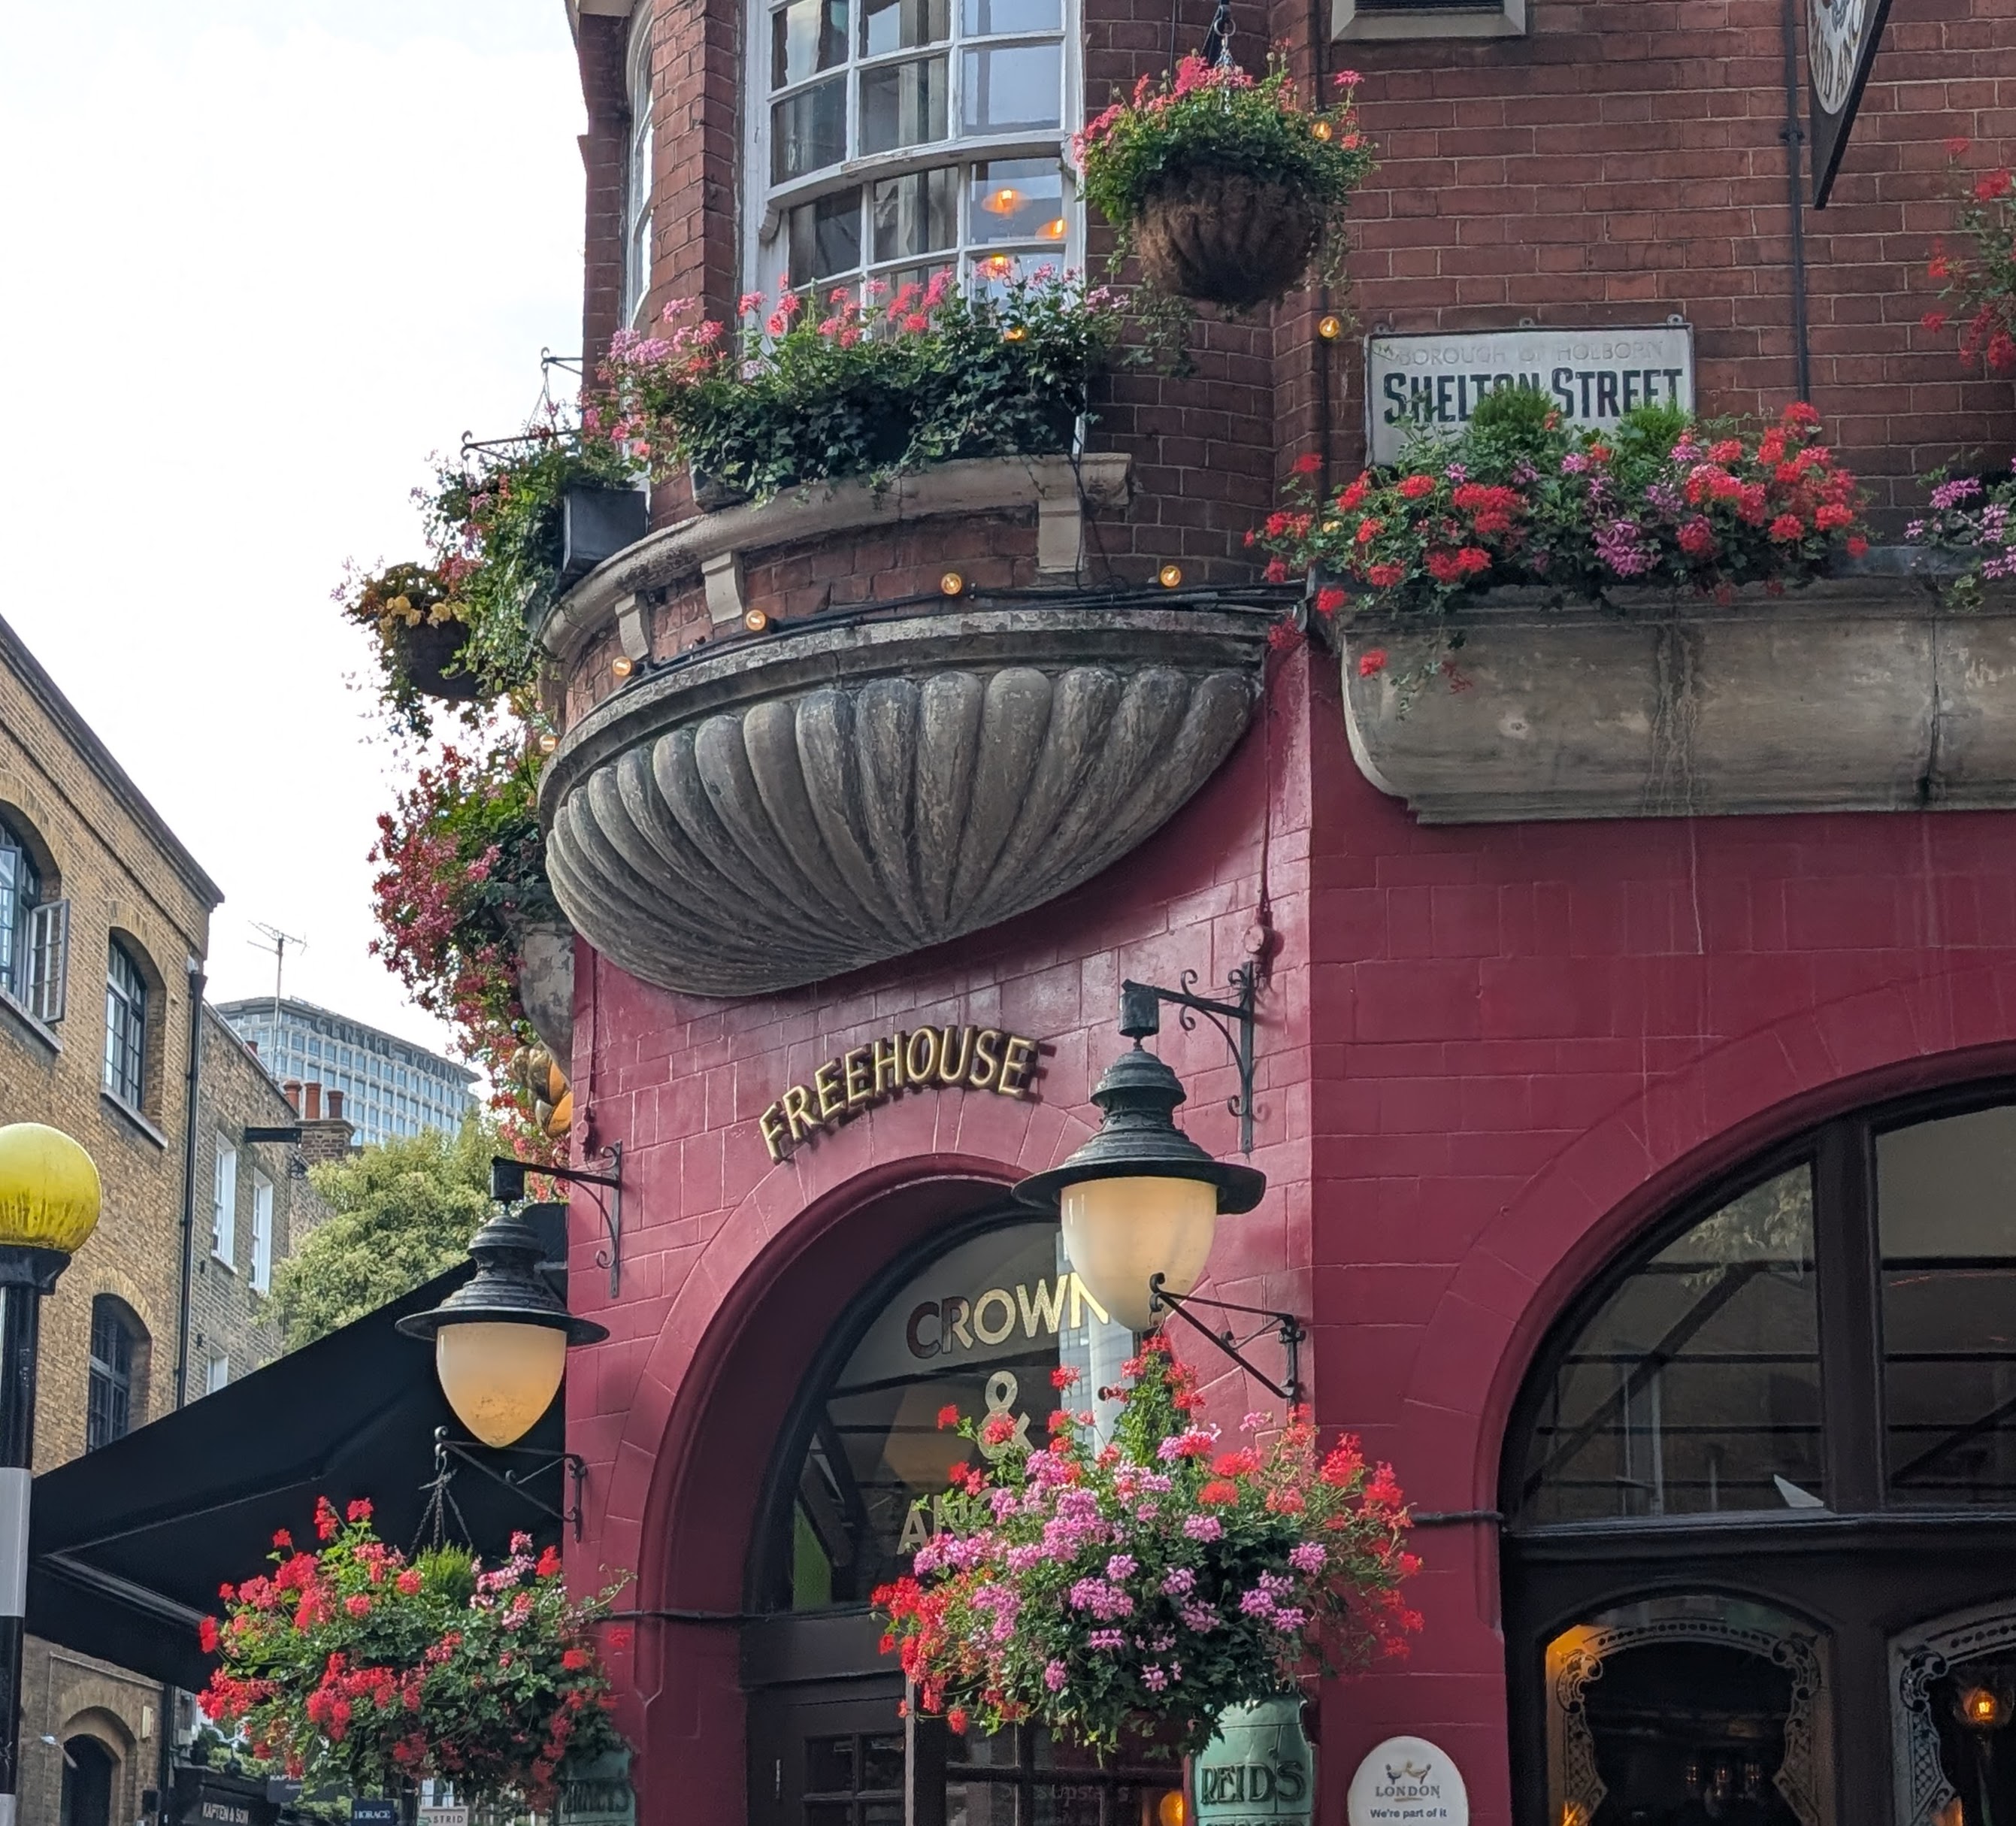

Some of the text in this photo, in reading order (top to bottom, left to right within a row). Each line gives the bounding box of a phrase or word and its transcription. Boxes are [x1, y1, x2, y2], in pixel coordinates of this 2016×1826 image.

[1399, 346, 1506, 365] BOROUGH
[1557, 341, 1663, 361] HOLBORN
[760, 1025, 1039, 1164] FREEHOUSE
[1376, 1785, 1440, 1797] LONDON
[354, 1810, 391, 1819] HORACE
[1370, 1808, 1447, 1819] We're part of it
